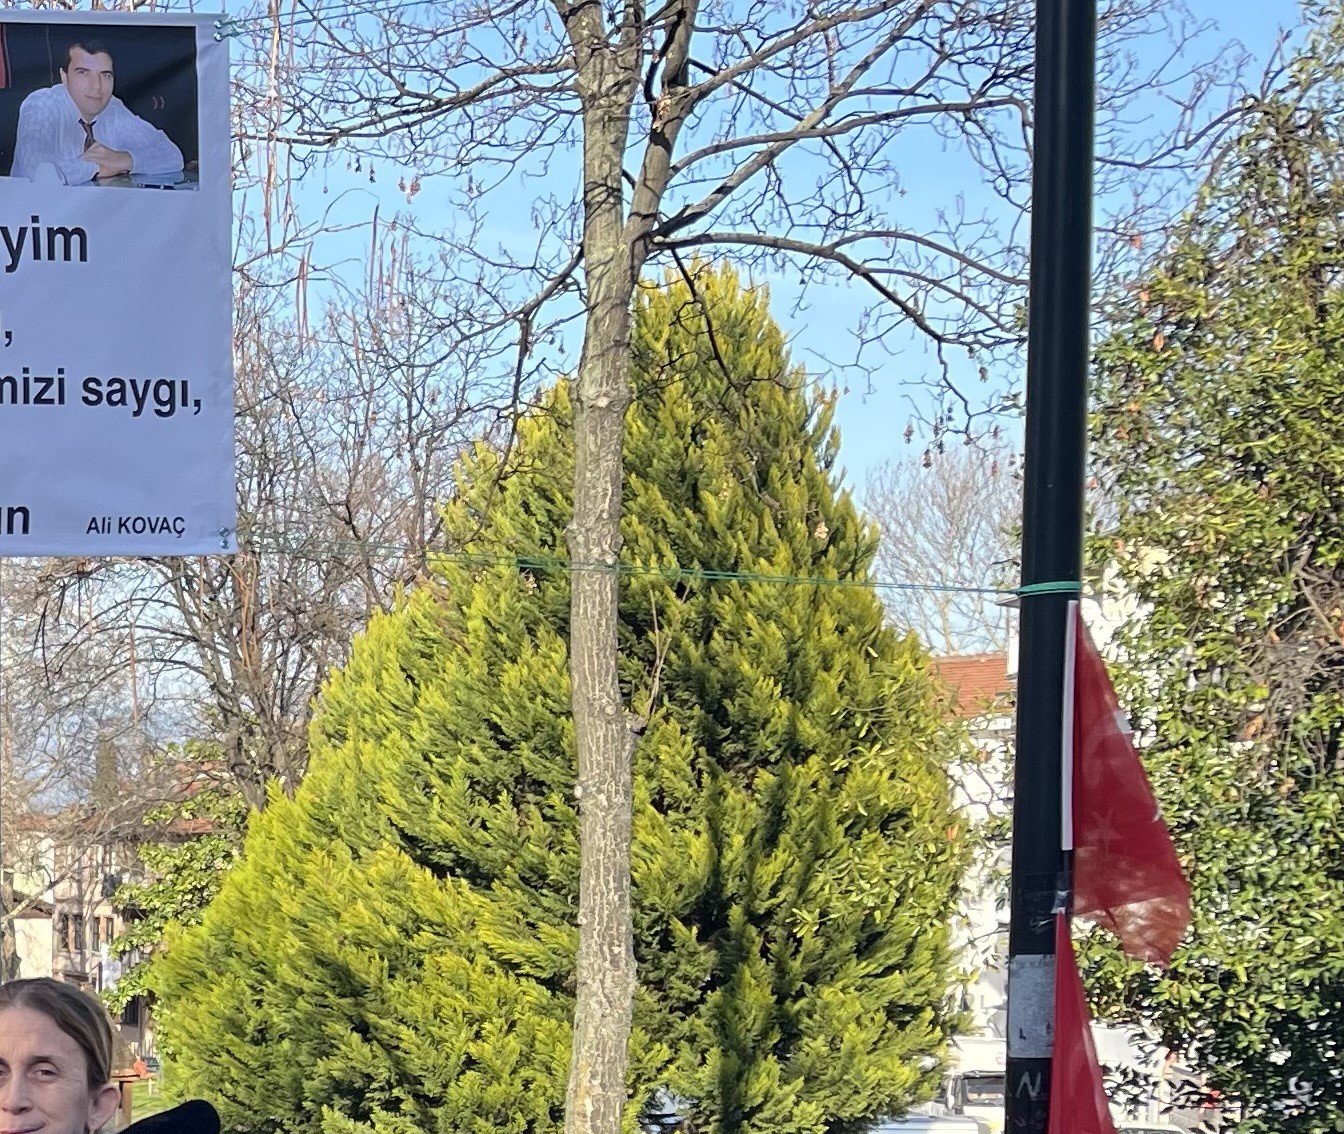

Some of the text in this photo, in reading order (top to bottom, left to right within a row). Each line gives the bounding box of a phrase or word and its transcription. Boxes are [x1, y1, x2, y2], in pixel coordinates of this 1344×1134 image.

[81, 376, 202, 418] saygı,
[85, 516, 186, 539] Ali KOVAÇ
